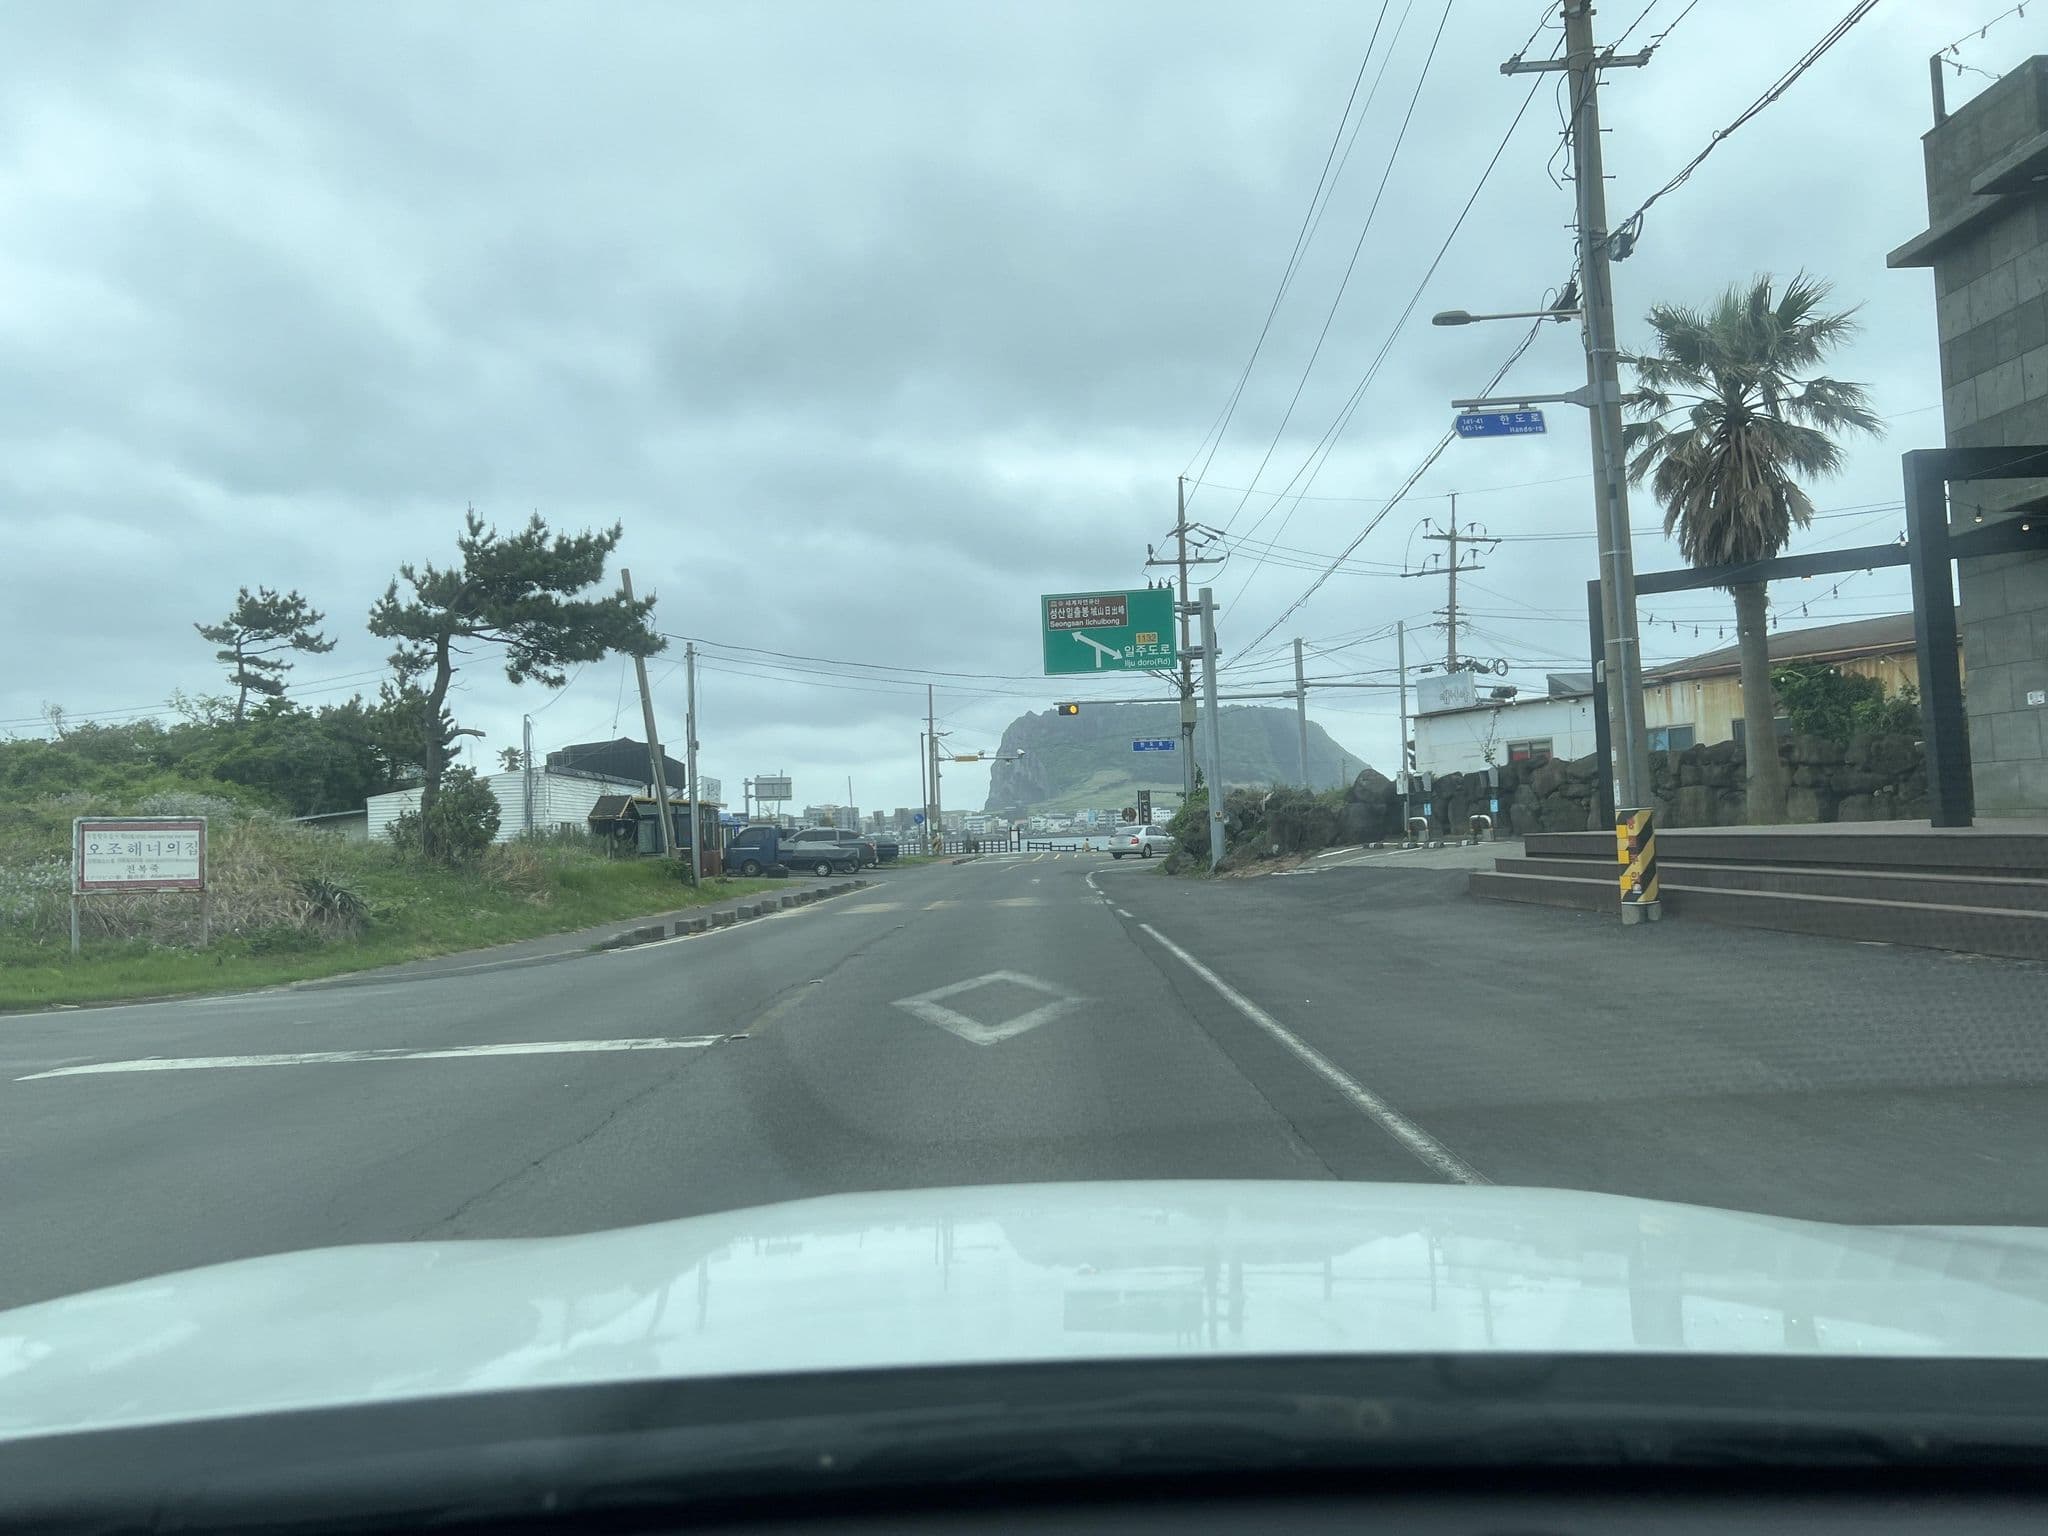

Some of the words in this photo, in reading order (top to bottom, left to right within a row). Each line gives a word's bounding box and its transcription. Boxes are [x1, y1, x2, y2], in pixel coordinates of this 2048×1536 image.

[1499, 413, 1541, 425] 한도로
[1509, 425, 1543, 433] Hando-ro
[1050, 605, 1089, 619] 성산일출봉
[1050, 619, 1084, 628] Seongsan
[1085, 617, 1120, 626] Ilchulbong
[1137, 633, 1157, 644] 1132
[1124, 644, 1172, 657] 일주도로
[1124, 660, 1136, 668] Ilju
[1137, 658, 1171, 667] doro(Rd)
